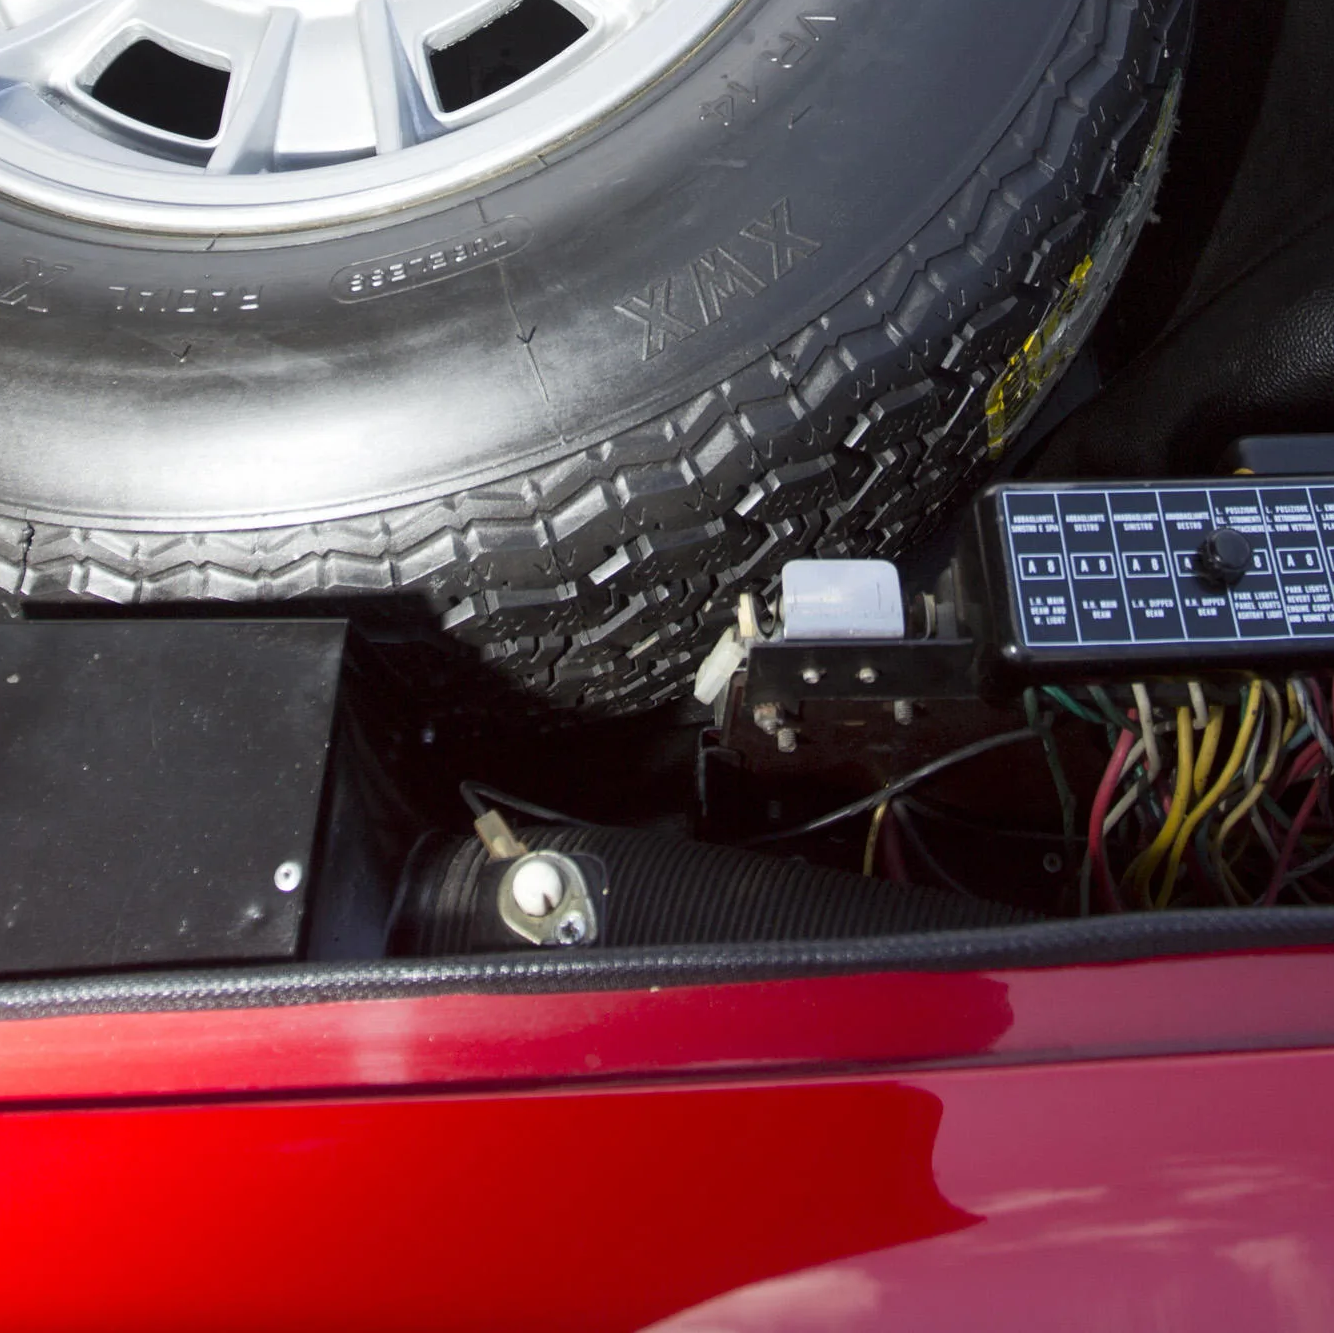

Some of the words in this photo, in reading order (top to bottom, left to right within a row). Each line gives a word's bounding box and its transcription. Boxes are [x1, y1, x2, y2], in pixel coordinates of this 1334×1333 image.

[761, 13, 842, 70] VR
[349, 233, 507, 293] TUBELESS
[614, 196, 823, 361] XWX
[109, 284, 262, 314] RADIAL
[1176, 521, 1202, 530] DESTRO
[1305, 585, 1328, 593] LIGHTS
[1234, 592, 1252, 600] PARK
[1254, 591, 1278, 600] LIGHTS
[1312, 594, 1330, 602] LIGHT
[1047, 597, 1064, 605] MAIN
[1100, 600, 1117, 608] MAIN
[1235, 602, 1255, 610] PANEL
[1258, 601, 1281, 609] LIGHTS
[1031, 607, 1049, 615] BEAM
[1052, 606, 1066, 615] AND
[1092, 610, 1111, 619] BEAM
[1145, 609, 1164, 618] BEAM
[1198, 608, 1217, 616] BEAM
[1046, 616, 1065, 625] LIGHT
